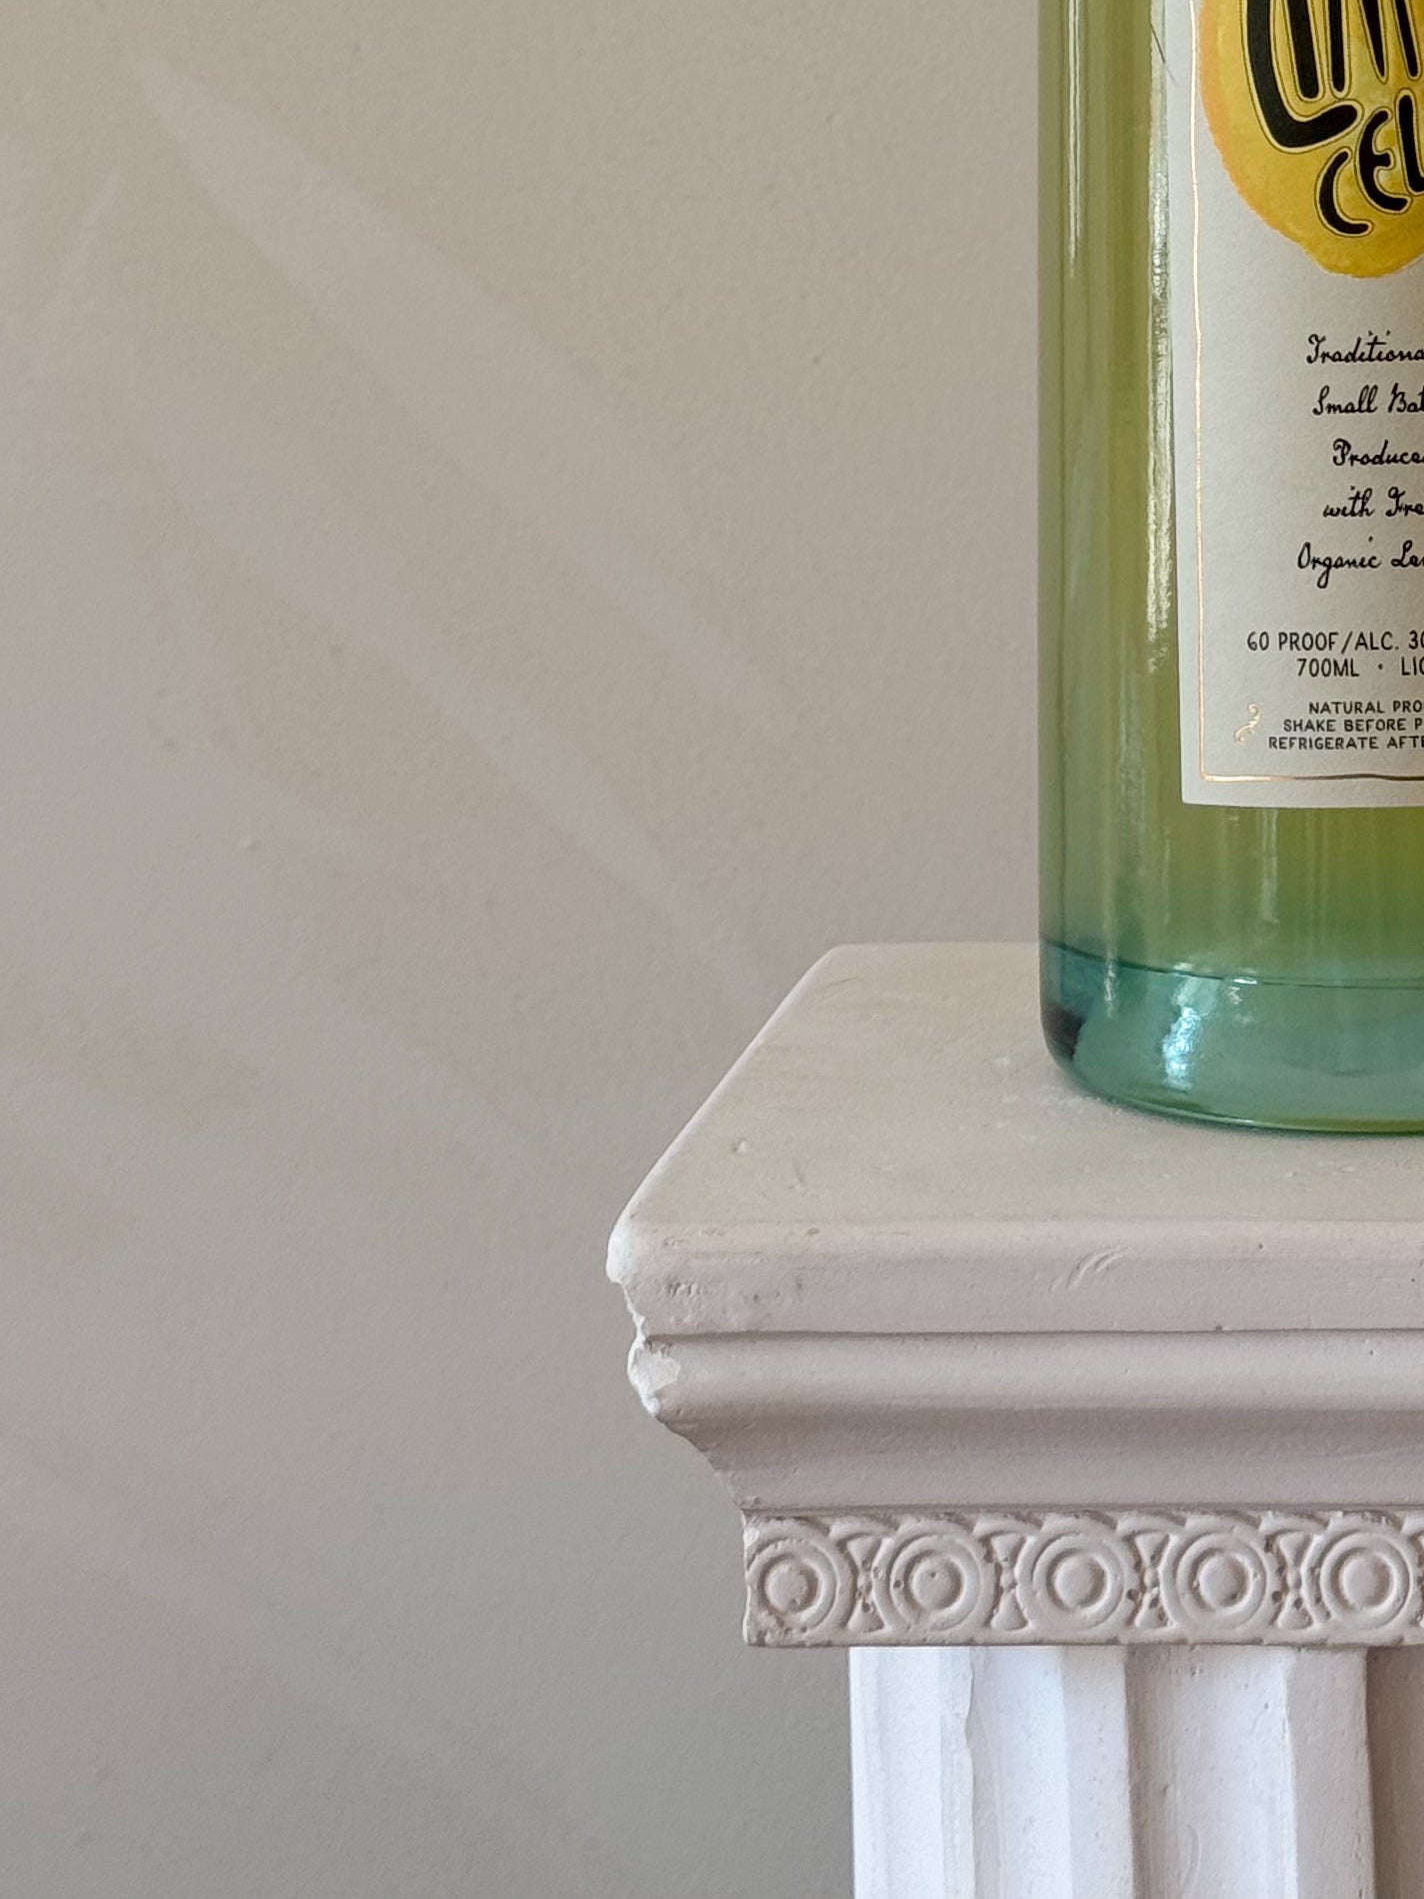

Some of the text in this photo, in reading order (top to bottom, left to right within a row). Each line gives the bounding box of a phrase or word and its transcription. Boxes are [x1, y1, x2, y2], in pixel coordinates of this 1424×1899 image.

[1312, 385, 1377, 415] Small
[1323, 486, 1374, 517] with
[1297, 536, 1381, 589] Organic
[1247, 632, 1269, 651] 60
[1278, 630, 1399, 653] PROOF/ALC.
[1296, 658, 1360, 678] 700ML
[1309, 701, 1385, 714] NATURAL
[1283, 719, 1336, 733] SHAKE
[1344, 717, 1407, 733] BEFORE
[1269, 736, 1378, 751] REFRIGERATE
